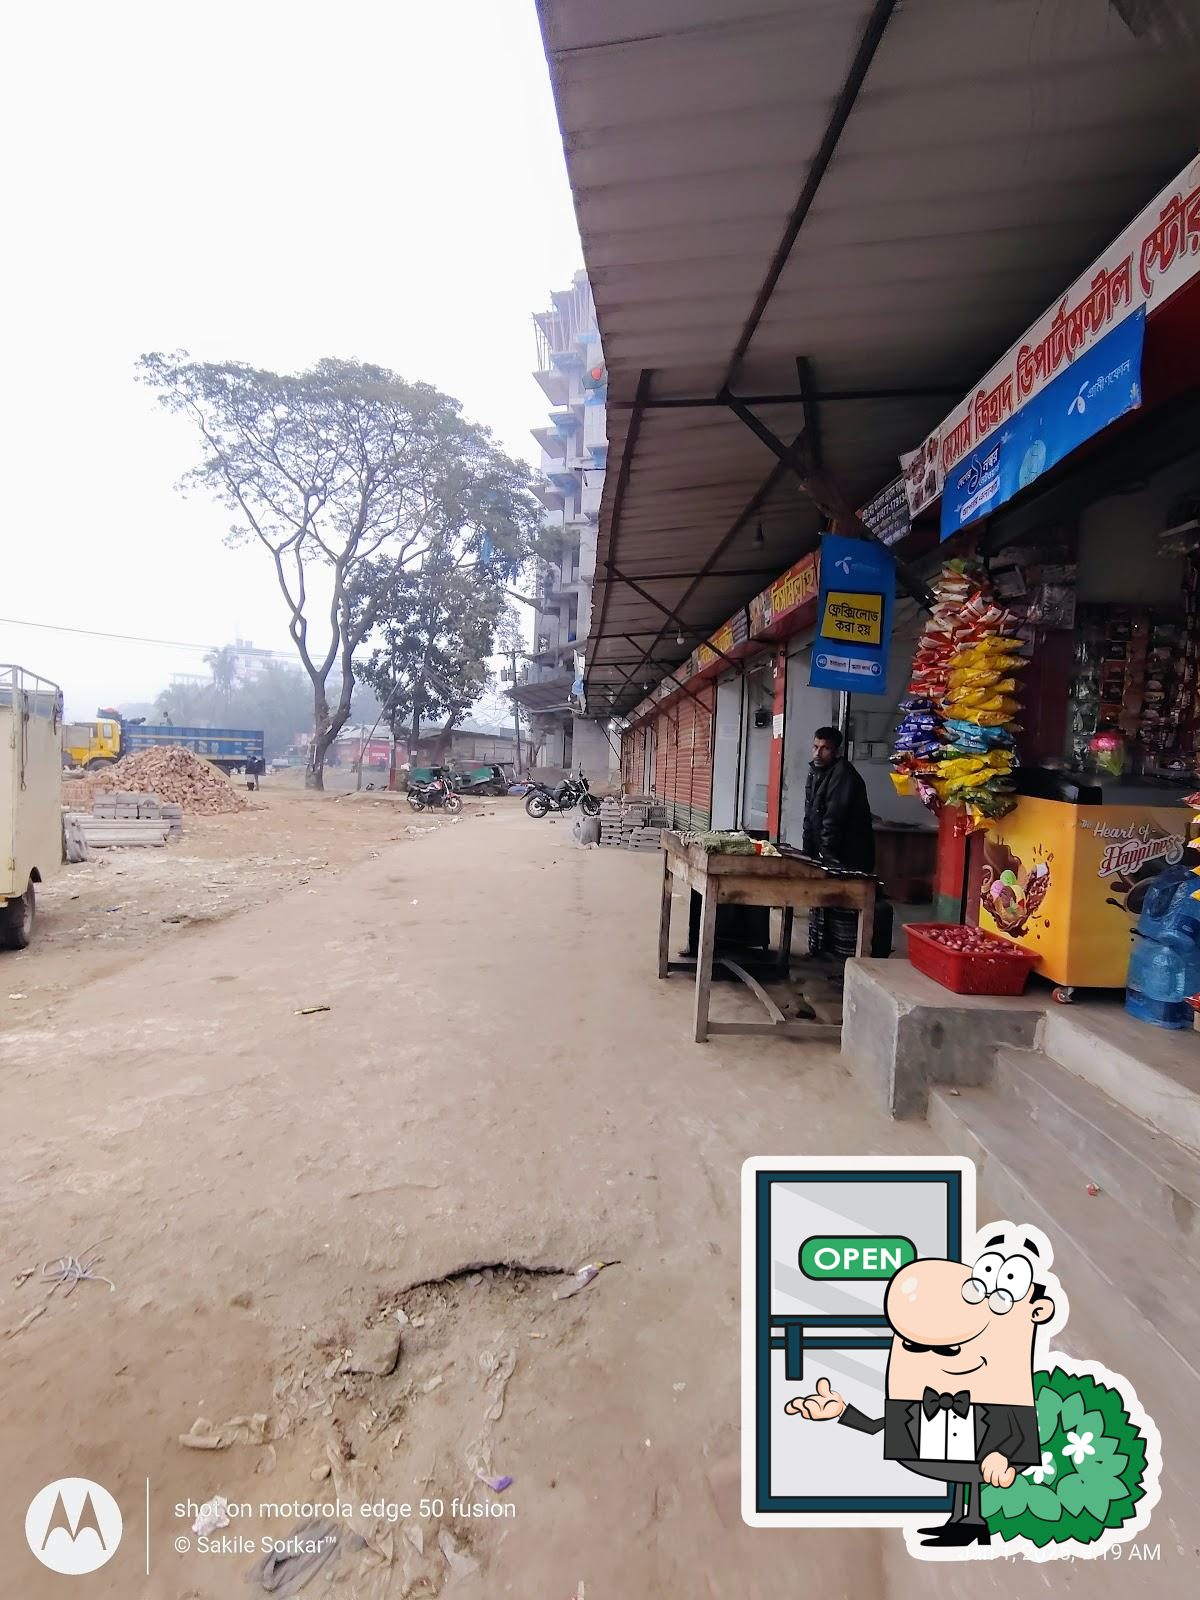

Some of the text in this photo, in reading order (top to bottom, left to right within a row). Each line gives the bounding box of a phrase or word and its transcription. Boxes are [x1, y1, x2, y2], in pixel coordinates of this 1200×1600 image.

[834, 619, 872, 636] করা হয়
[1093, 821, 1135, 839] Heart
[1098, 835, 1185, 876] Happiness
